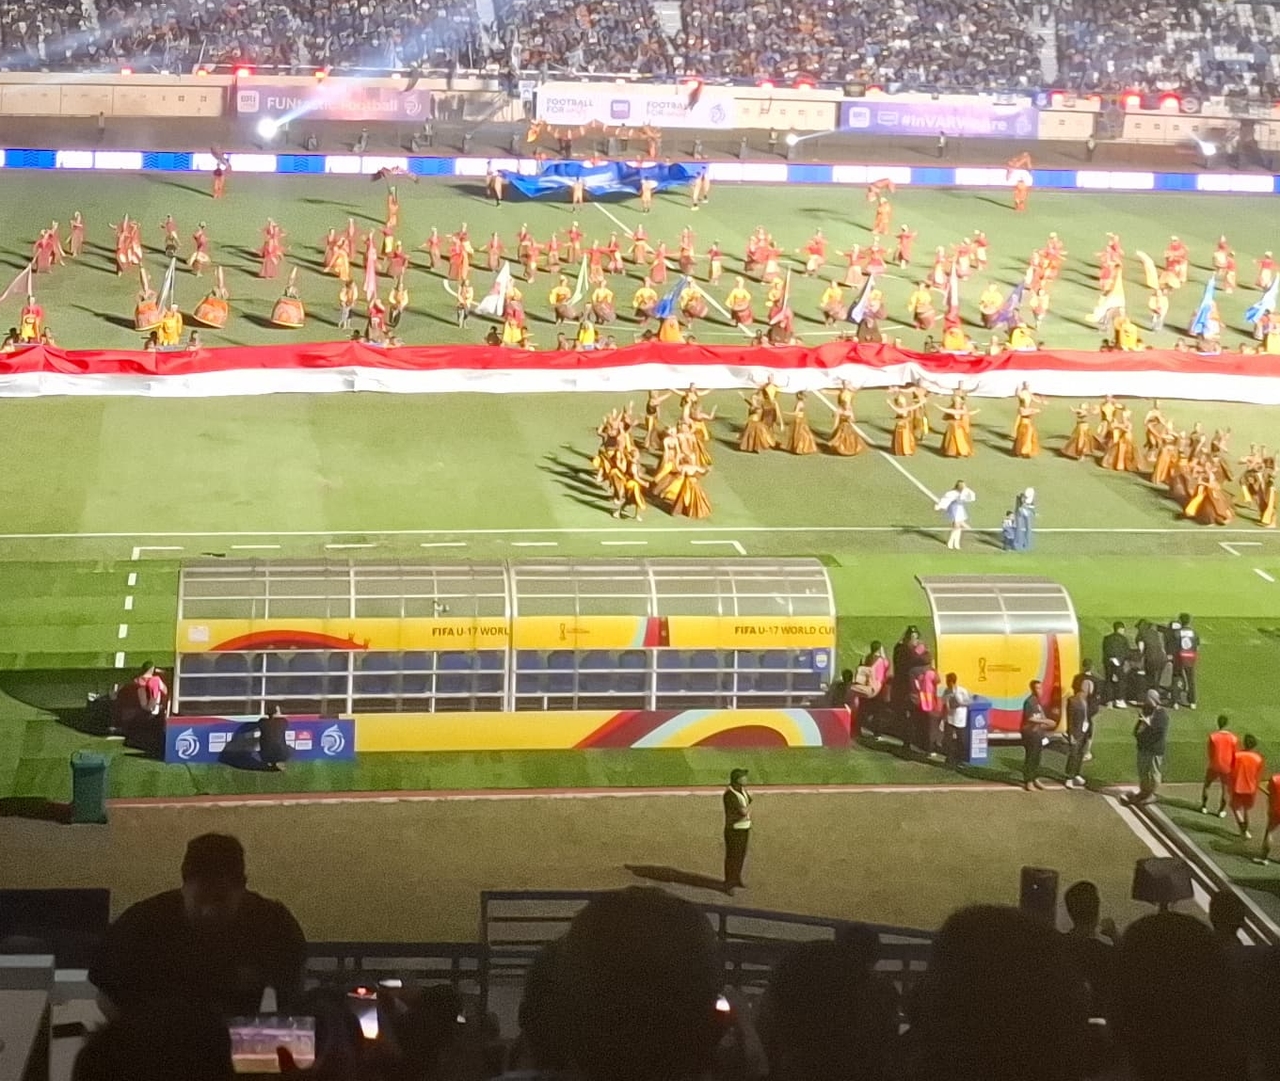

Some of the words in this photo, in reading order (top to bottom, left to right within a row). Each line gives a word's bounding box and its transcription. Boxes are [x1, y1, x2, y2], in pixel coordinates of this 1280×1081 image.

[546, 98, 594, 107] FOOTBALL
[432, 627, 454, 636] FIFA
[734, 626, 756, 635] FIFA
[758, 626, 778, 635] U-17
[781, 626, 816, 635] WORLD
